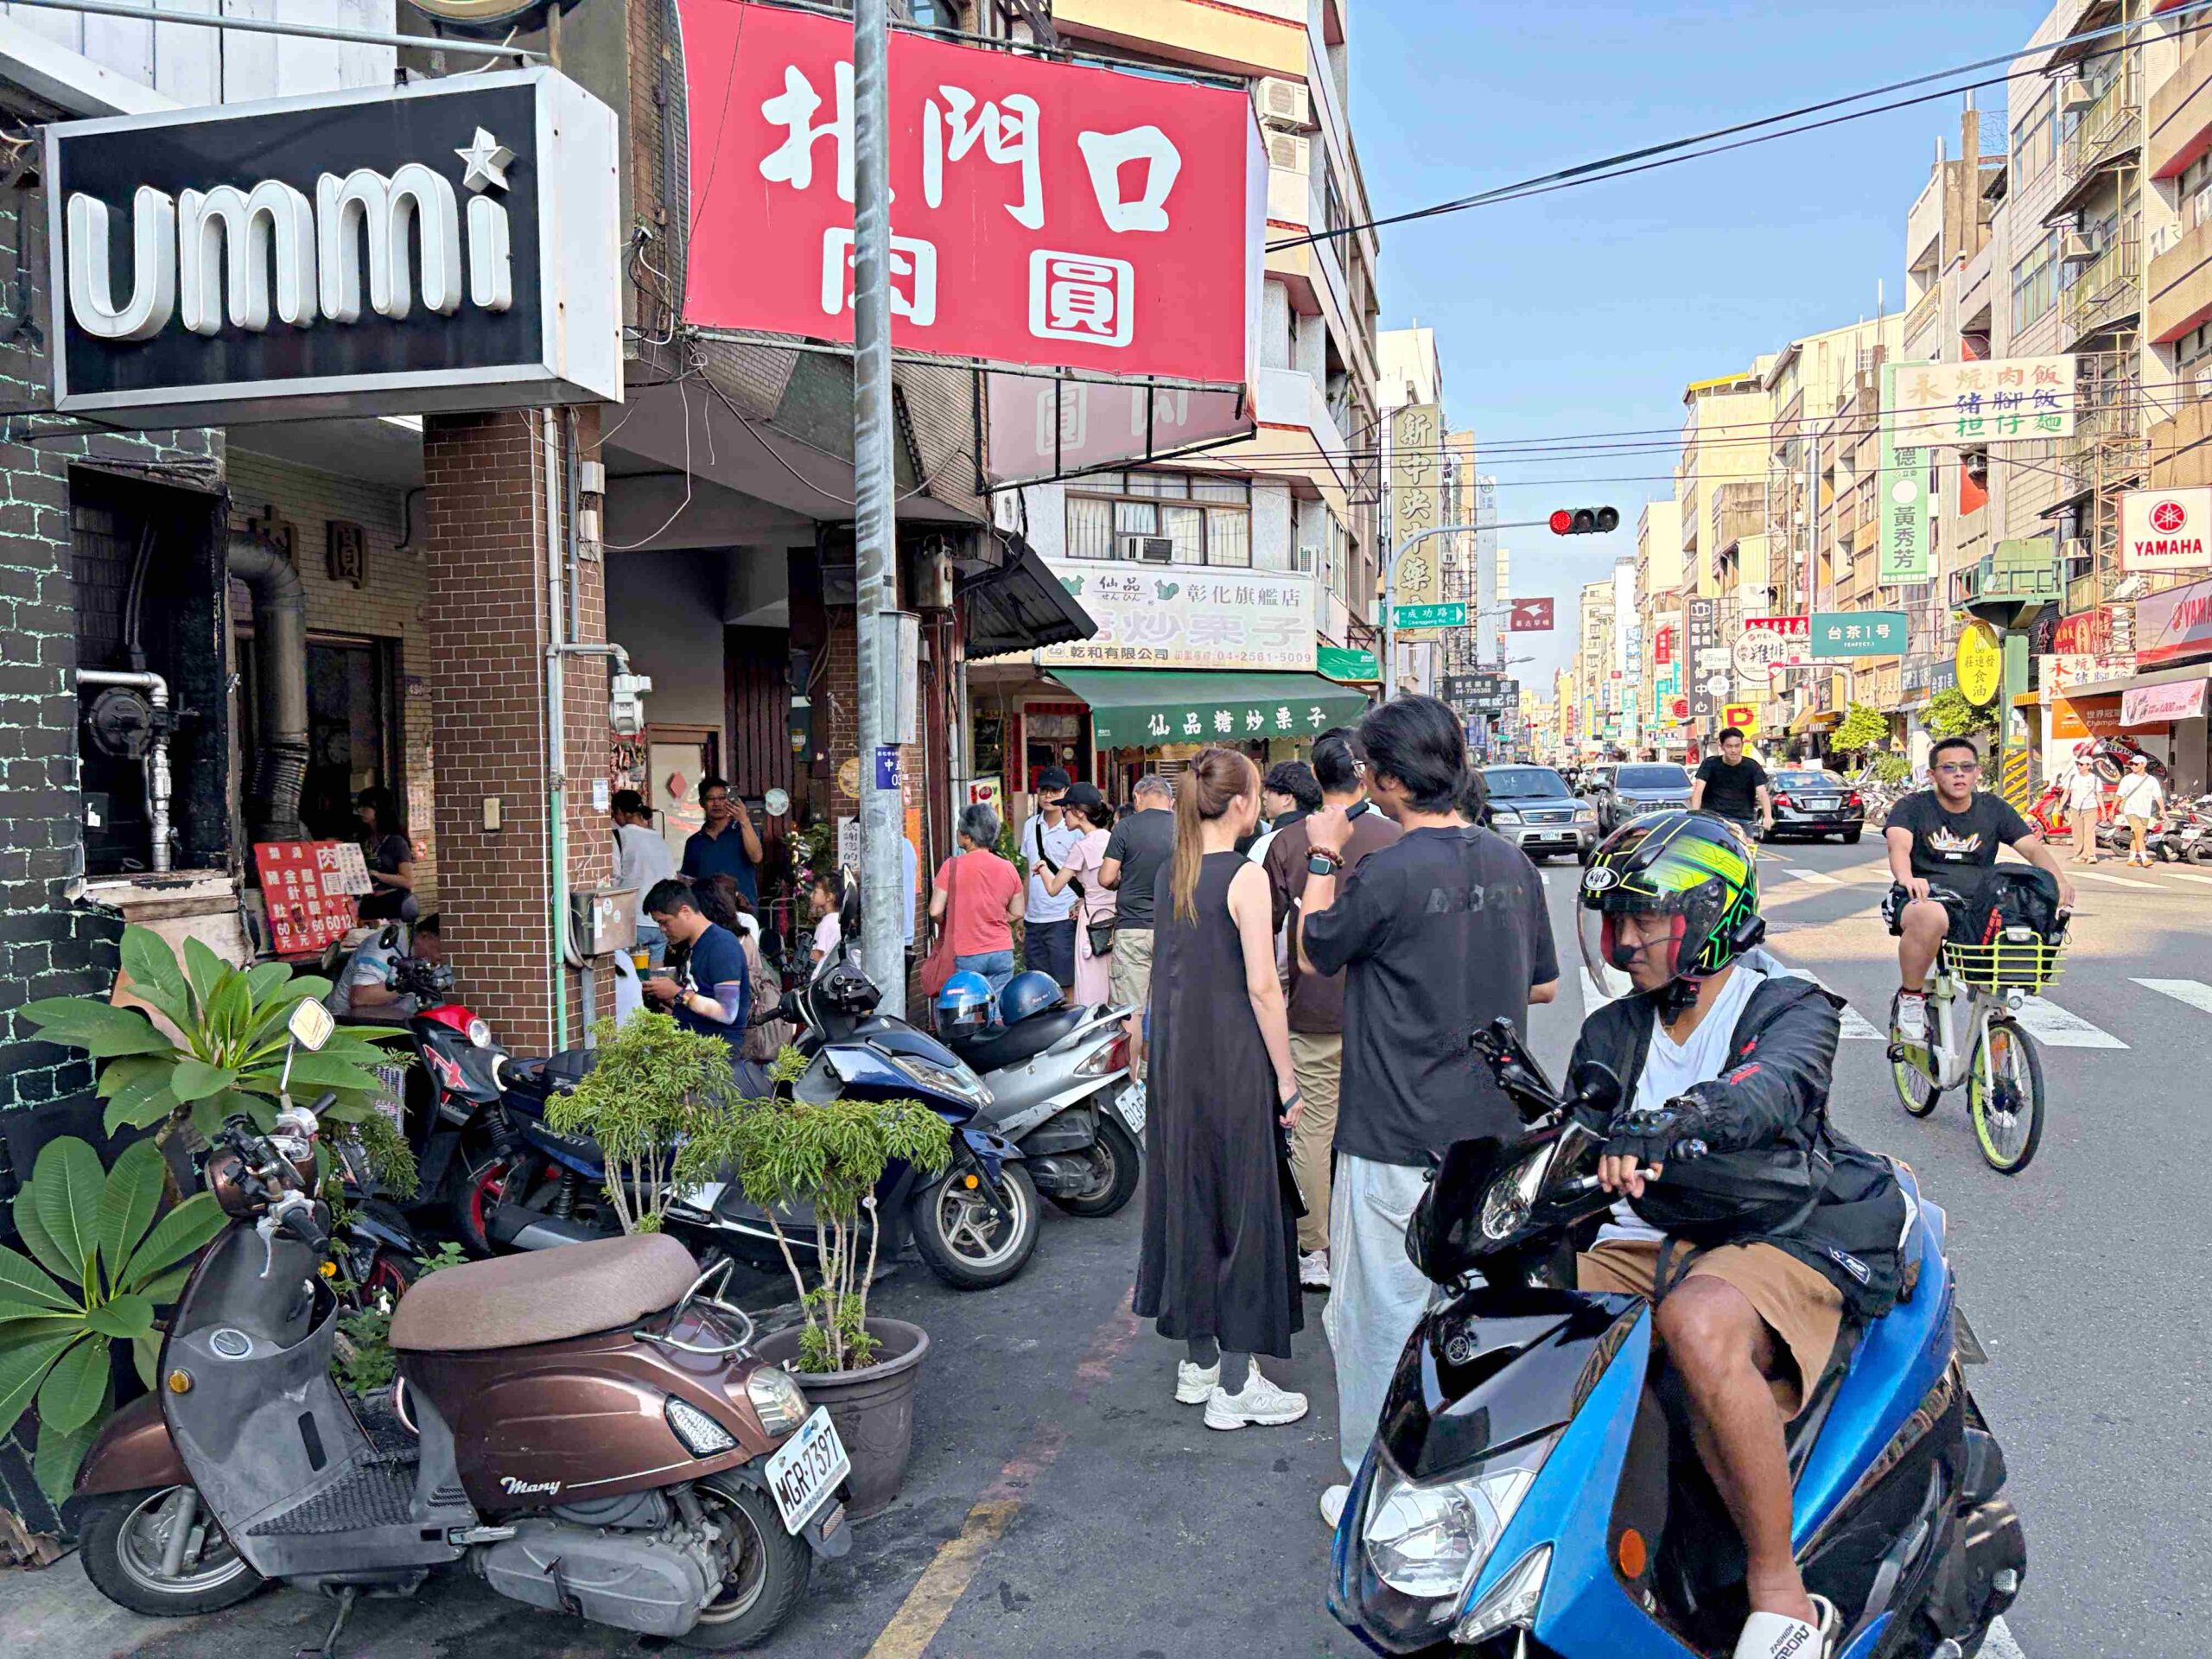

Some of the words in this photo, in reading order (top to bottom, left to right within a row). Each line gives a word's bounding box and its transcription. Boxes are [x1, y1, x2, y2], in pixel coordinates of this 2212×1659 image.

[822, 226, 1134, 346] 肉圓
[1894, 506, 1915, 569] 黃秀芳
[2134, 538, 2202, 556] YAMAHA
[1100, 575, 1141, 592] 仙品
[1187, 582, 1301, 607] 彰化旗艦店
[1408, 607, 1448, 619] 成功路
[1827, 624, 1891, 640] 台茶1号
[1071, 646, 1168, 660] 乾和有限公司
[1147, 707, 1326, 736] 仙品糖炒栗子
[326, 915, 340, 930] 60
[776, 1425, 839, 1516] MGR-7397
[500, 1476, 561, 1495] Many
[1770, 1624, 1796, 1654] FASHION
